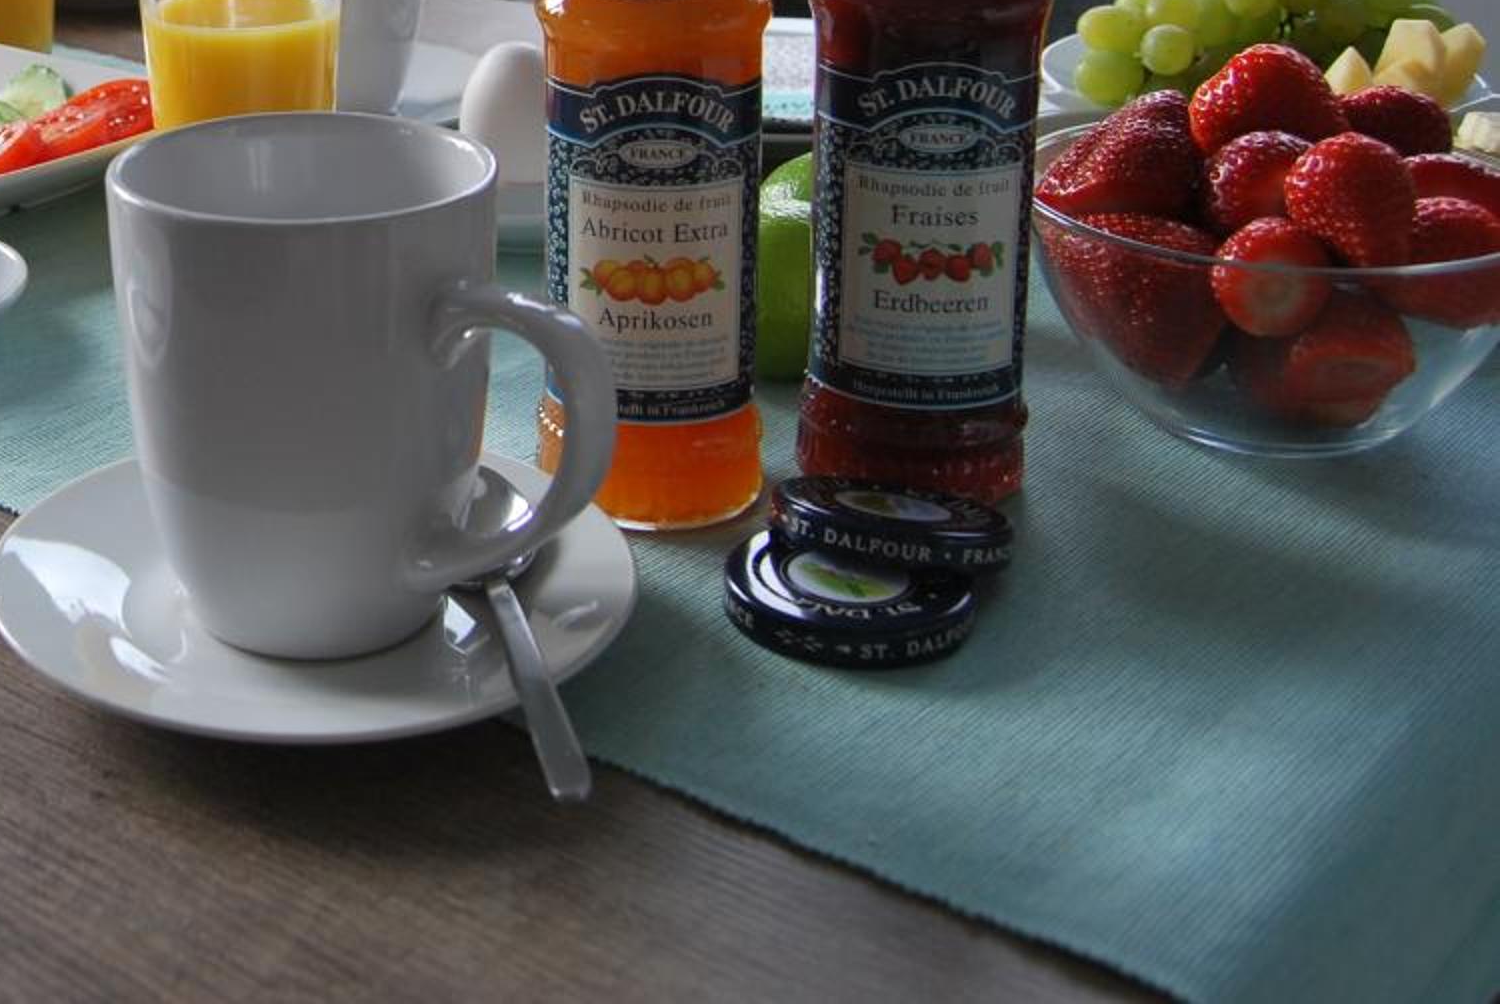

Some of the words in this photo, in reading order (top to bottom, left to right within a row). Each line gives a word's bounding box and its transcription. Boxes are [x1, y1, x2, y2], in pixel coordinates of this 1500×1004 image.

[858, 94, 894, 117] ST.
[897, 76, 1016, 121] DALFOUR
[580, 105, 615, 133] ST.
[617, 90, 735, 133] DALFOUR
[908, 132, 966, 145] FRANCE
[629, 147, 687, 160] FRANCE
[859, 176, 946, 198] Rhapsodie
[952, 181, 973, 197] de
[979, 177, 1009, 196] fruit
[582, 191, 669, 213] Rhapsodie
[674, 195, 693, 212] de
[699, 191, 732, 211] fruit
[891, 204, 979, 227] Fraises
[581, 222, 663, 244] Abricot
[675, 223, 728, 243] Extra
[873, 290, 989, 314] Erdbeeren
[598, 308, 712, 333] Aprikosen
[824, 529, 932, 563] DALFOUR
